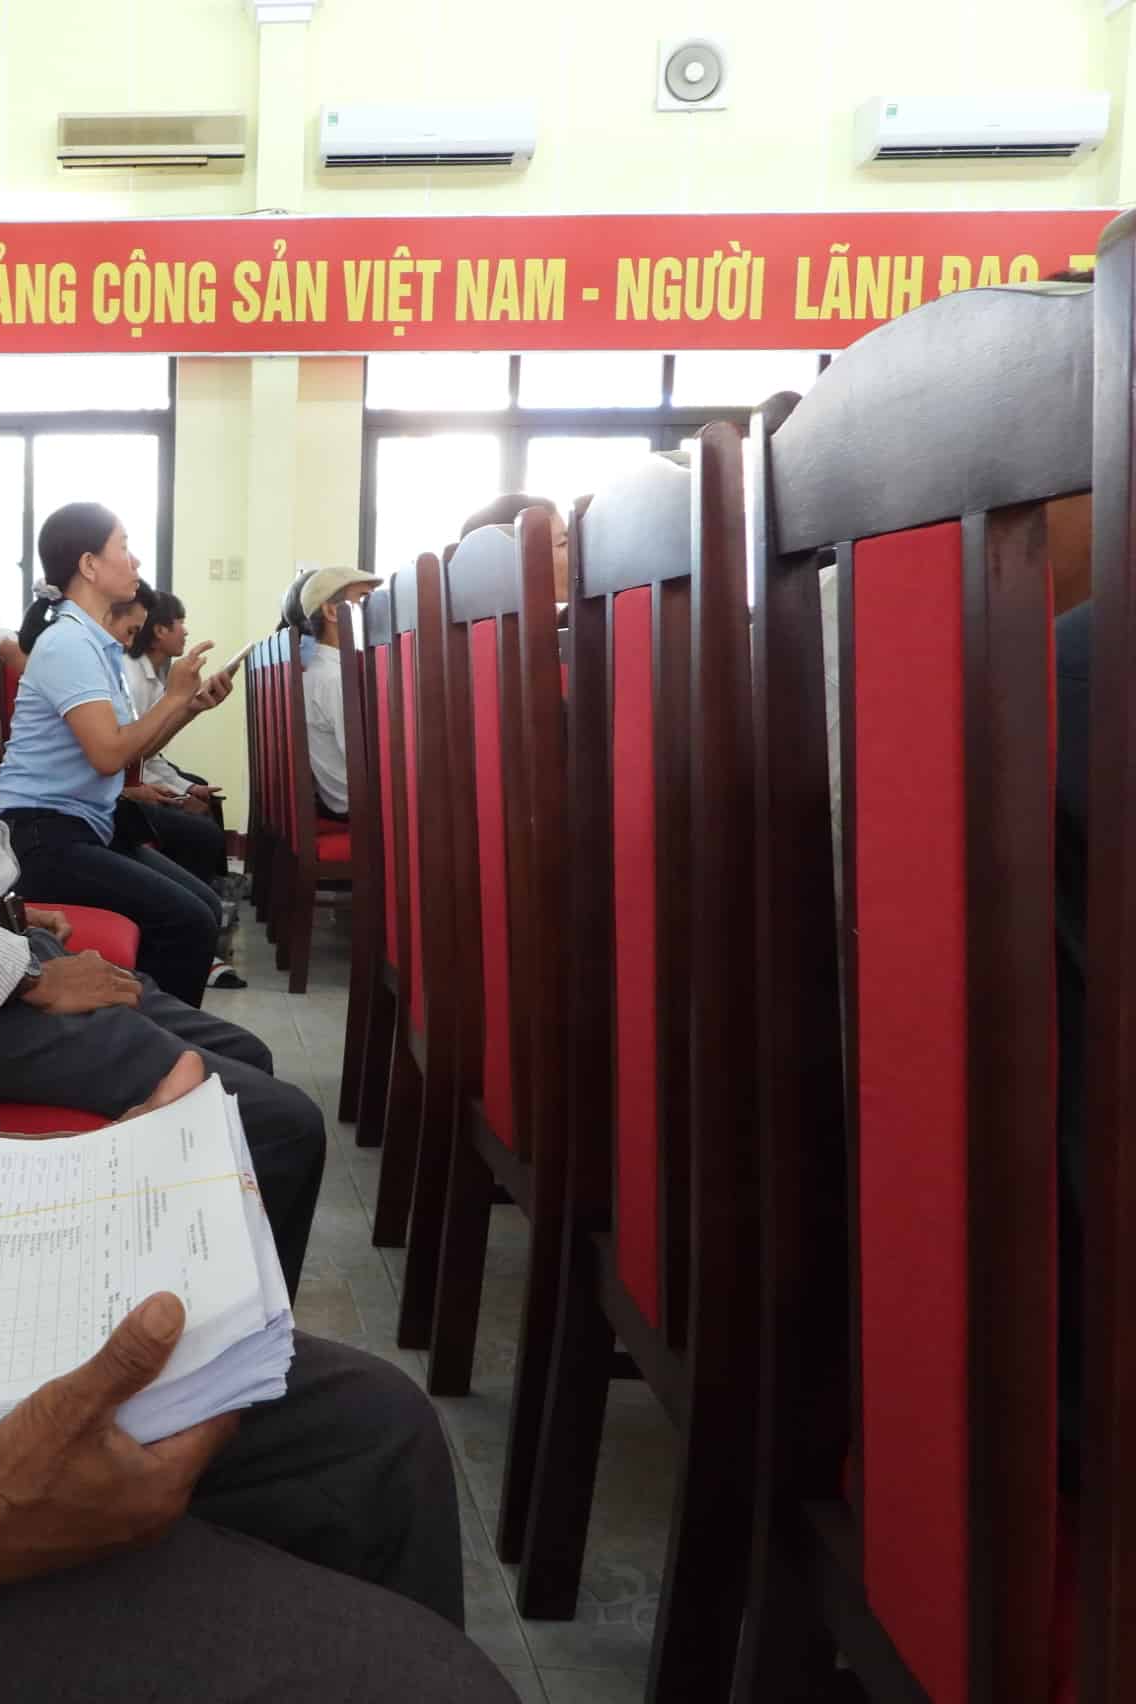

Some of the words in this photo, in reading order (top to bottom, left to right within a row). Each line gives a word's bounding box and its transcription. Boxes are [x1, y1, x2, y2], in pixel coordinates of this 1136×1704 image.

[92, 248, 217, 338] CỘNG
[232, 239, 329, 322] SẢN
[343, 245, 443, 337] VIỆT
[455, 258, 567, 321] NAM
[582, 287, 600, 301] -
[615, 240, 766, 321] NGƯỜI
[795, 243, 925, 320] LÃNH
